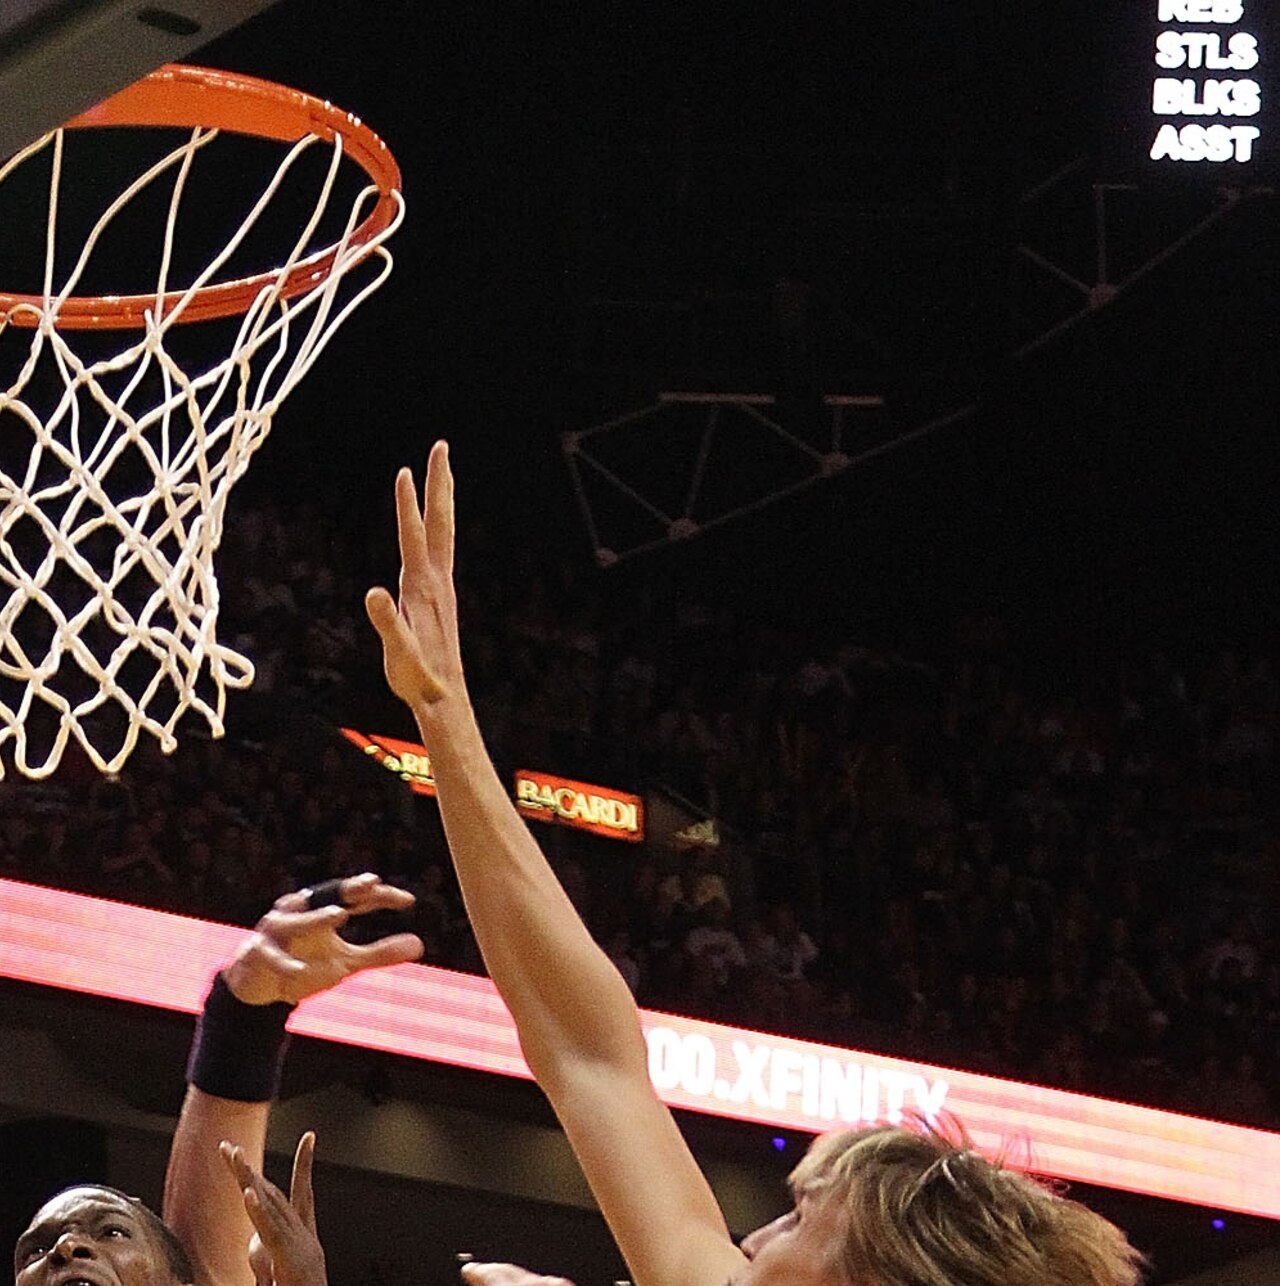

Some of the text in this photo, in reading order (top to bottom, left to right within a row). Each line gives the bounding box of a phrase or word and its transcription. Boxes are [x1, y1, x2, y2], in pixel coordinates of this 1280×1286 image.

[1158, 0, 1244, 24] REB
[1155, 30, 1259, 70] STLS
[1152, 77, 1261, 117] BLKS
[1149, 123, 1261, 163] ASST
[518, 778, 639, 832] BACARDI
[646, 1027, 949, 1126] 00.XFINITY
